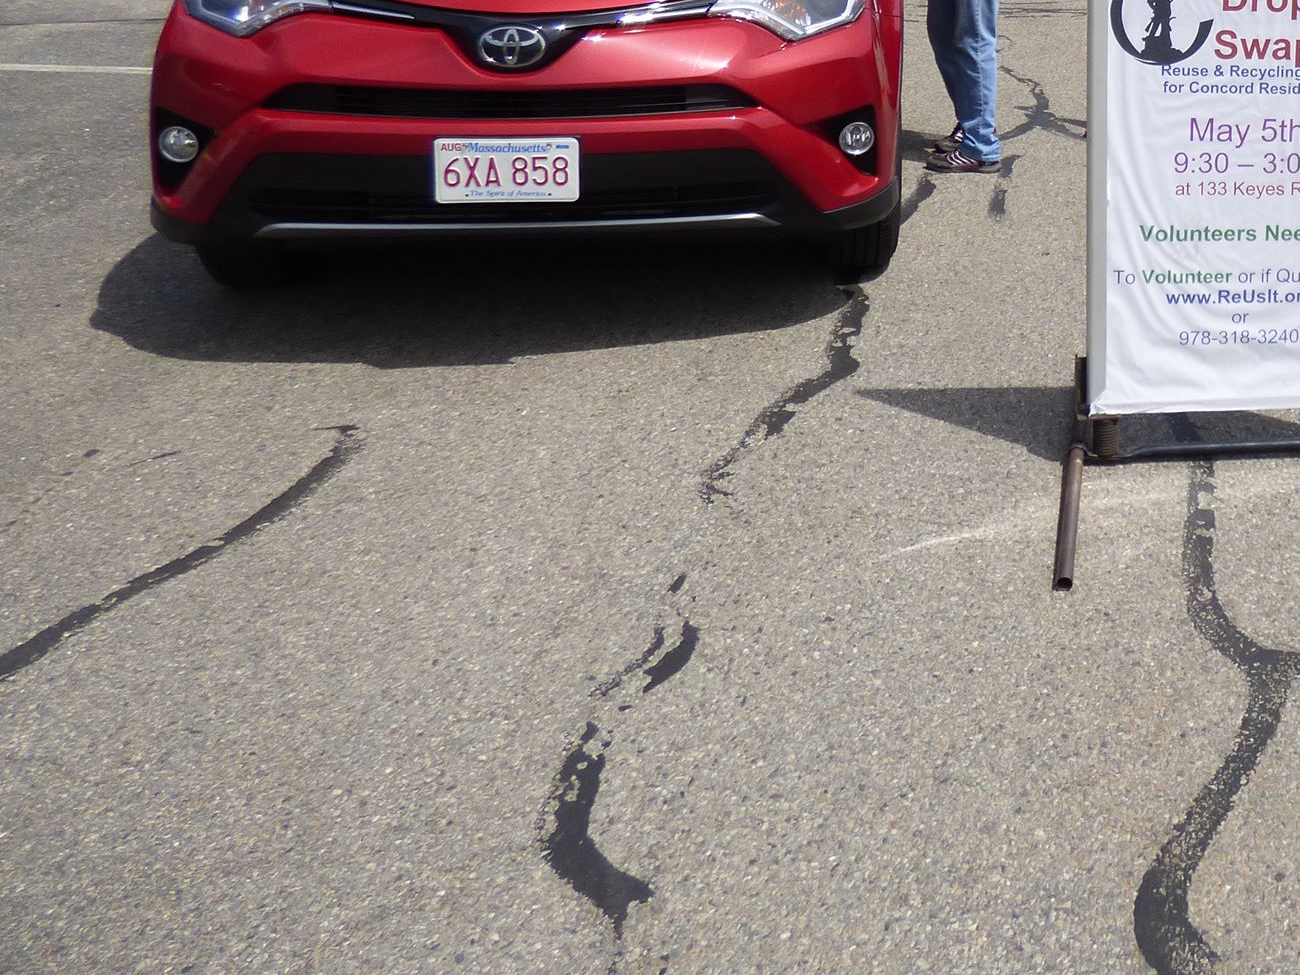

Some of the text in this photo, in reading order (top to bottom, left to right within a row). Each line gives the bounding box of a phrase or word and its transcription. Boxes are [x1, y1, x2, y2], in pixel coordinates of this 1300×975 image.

[1161, 65, 1208, 77] Reuse
[1213, 66, 1225, 77] &
[1163, 82, 1185, 93] for
[1189, 82, 1254, 94] Concord
[1189, 117, 1250, 148] May
[467, 143, 545, 153] Massachusetts
[1173, 153, 1229, 174] 9:30
[444, 157, 569, 187] 6XA 858
[1175, 183, 1191, 195] at
[1198, 182, 1227, 195] 133
[1233, 182, 1285, 199] Keyes
[1139, 225, 1257, 242] Volunteers
[1113, 270, 1135, 285] To
[1141, 269, 1232, 284] Volunteer
[1238, 272, 1255, 283] or
[1261, 269, 1272, 283] if
[1231, 313, 1249, 324] or
[1179, 329, 1299, 345] 978-318-3240
